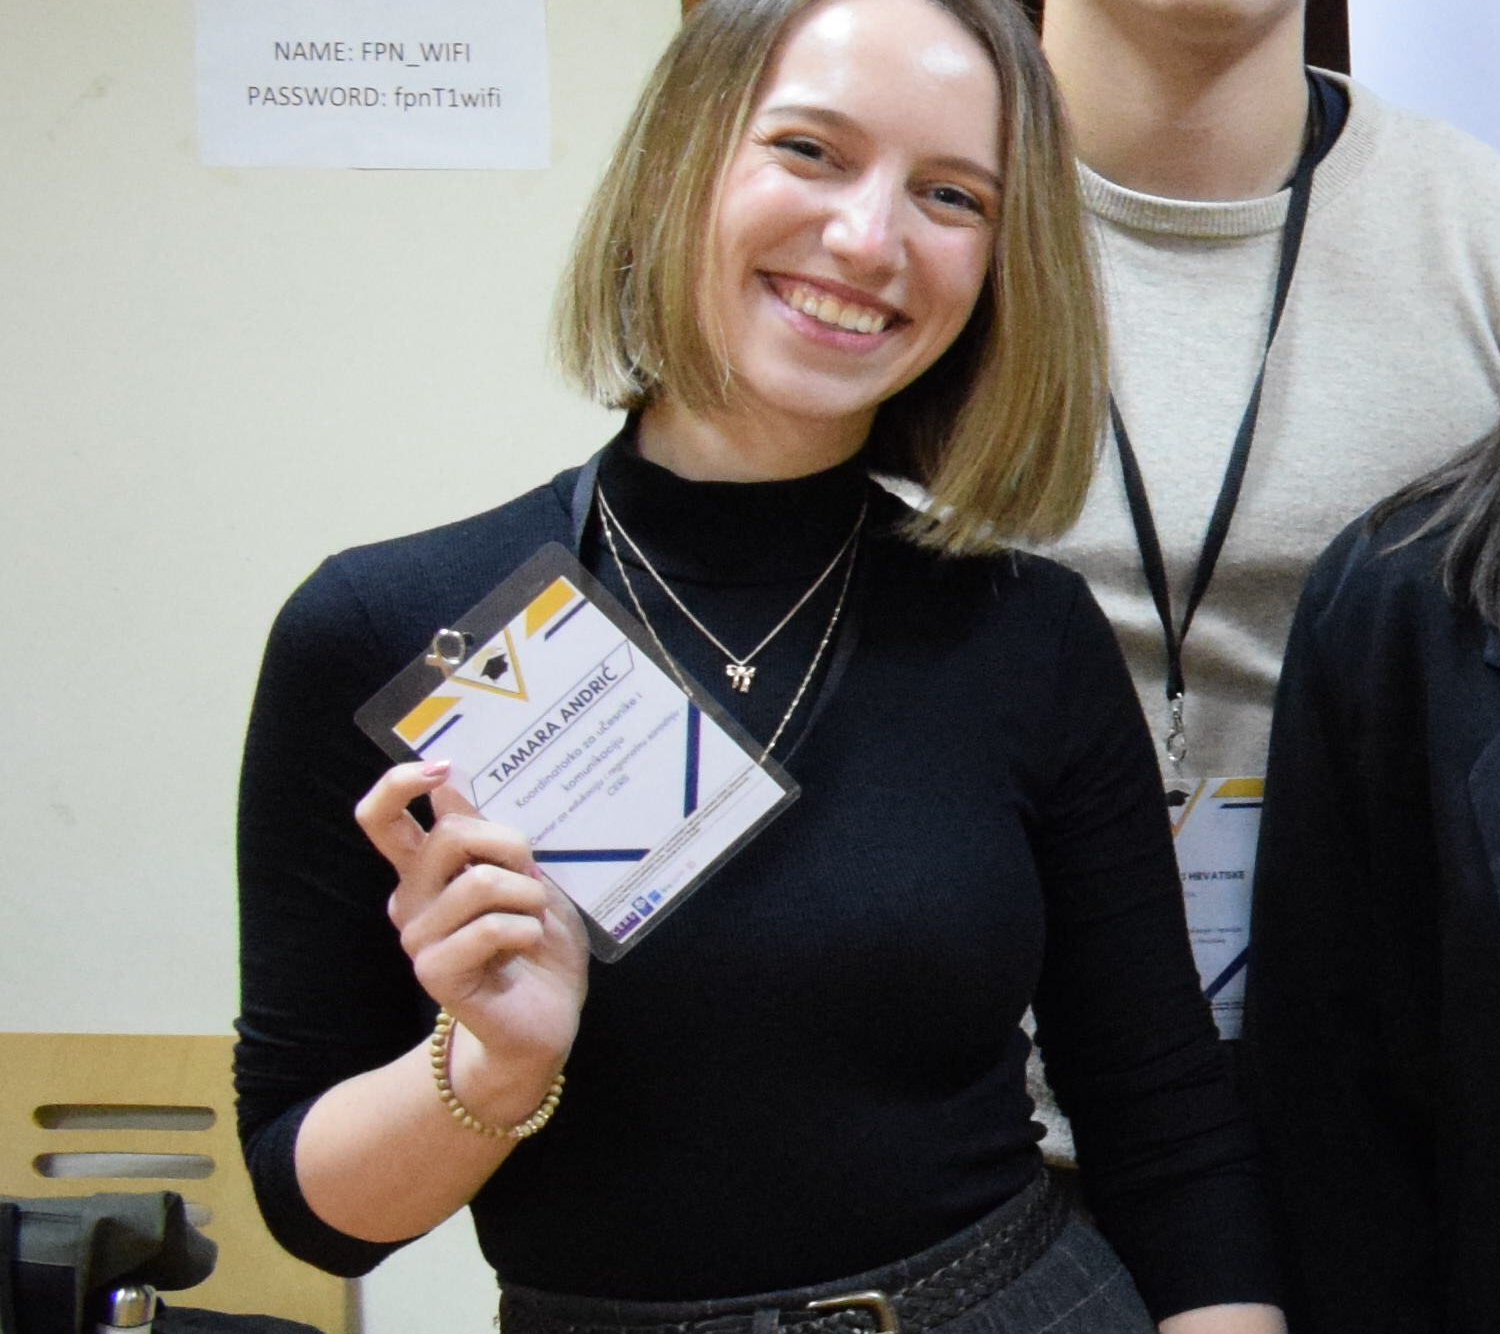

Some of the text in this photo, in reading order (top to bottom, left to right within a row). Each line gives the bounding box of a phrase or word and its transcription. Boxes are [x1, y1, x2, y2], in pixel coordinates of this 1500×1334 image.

[274, 42, 471, 67] NAME: FPN_WIFI
[247, 86, 502, 112] PASSWORD: fpnT1wifi
[487, 661, 619, 786] TAMARA ANDRIĆ
